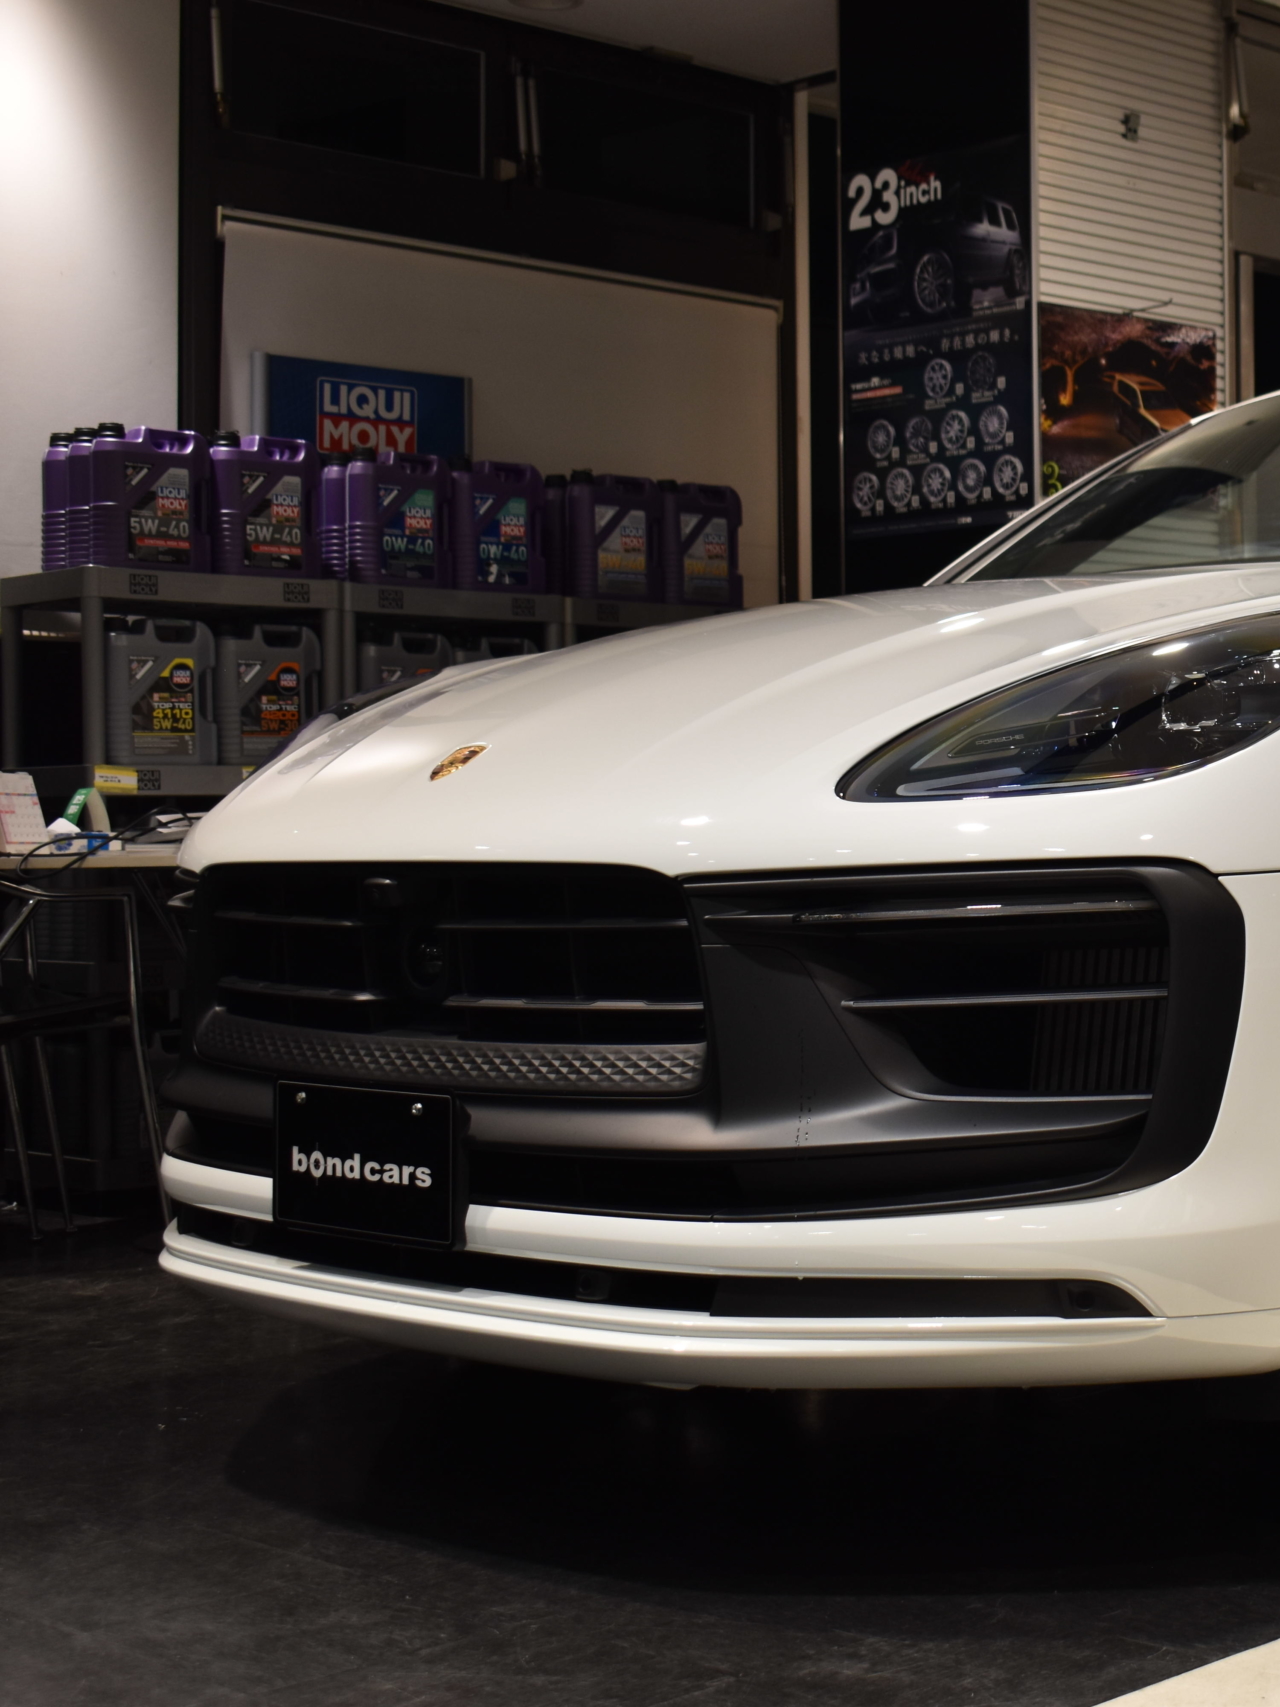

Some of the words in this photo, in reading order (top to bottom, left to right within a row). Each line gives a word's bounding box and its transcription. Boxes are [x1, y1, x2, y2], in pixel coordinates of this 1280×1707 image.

[323, 382, 411, 421] LIQUI
[323, 418, 414, 453] MOLY
[157, 487, 187, 498] LIQUI
[158, 498, 188, 510] MOLY
[273, 494, 299, 506] LIQUI
[273, 505, 300, 517] MOLY
[406, 507, 432, 518] LIQUI
[406, 517, 433, 529] MOLY
[501, 515, 525, 526] LIQUI
[129, 517, 190, 538] 5W-40
[502, 525, 526, 536] MOLY
[246, 524, 301, 545] 5W-40
[383, 535, 434, 555] 0W-40
[479, 543, 528, 562] 0W-40
[130, 574, 158, 584] LIQUI
[130, 584, 158, 595] MOLY
[284, 583, 309, 593] LIQUI
[284, 592, 310, 603] MOLY
[152, 709, 193, 719] 4110
[261, 711, 299, 720] 4200
[153, 718, 193, 730] 5W-40
[975, 733, 1025, 746] PORSCHE
